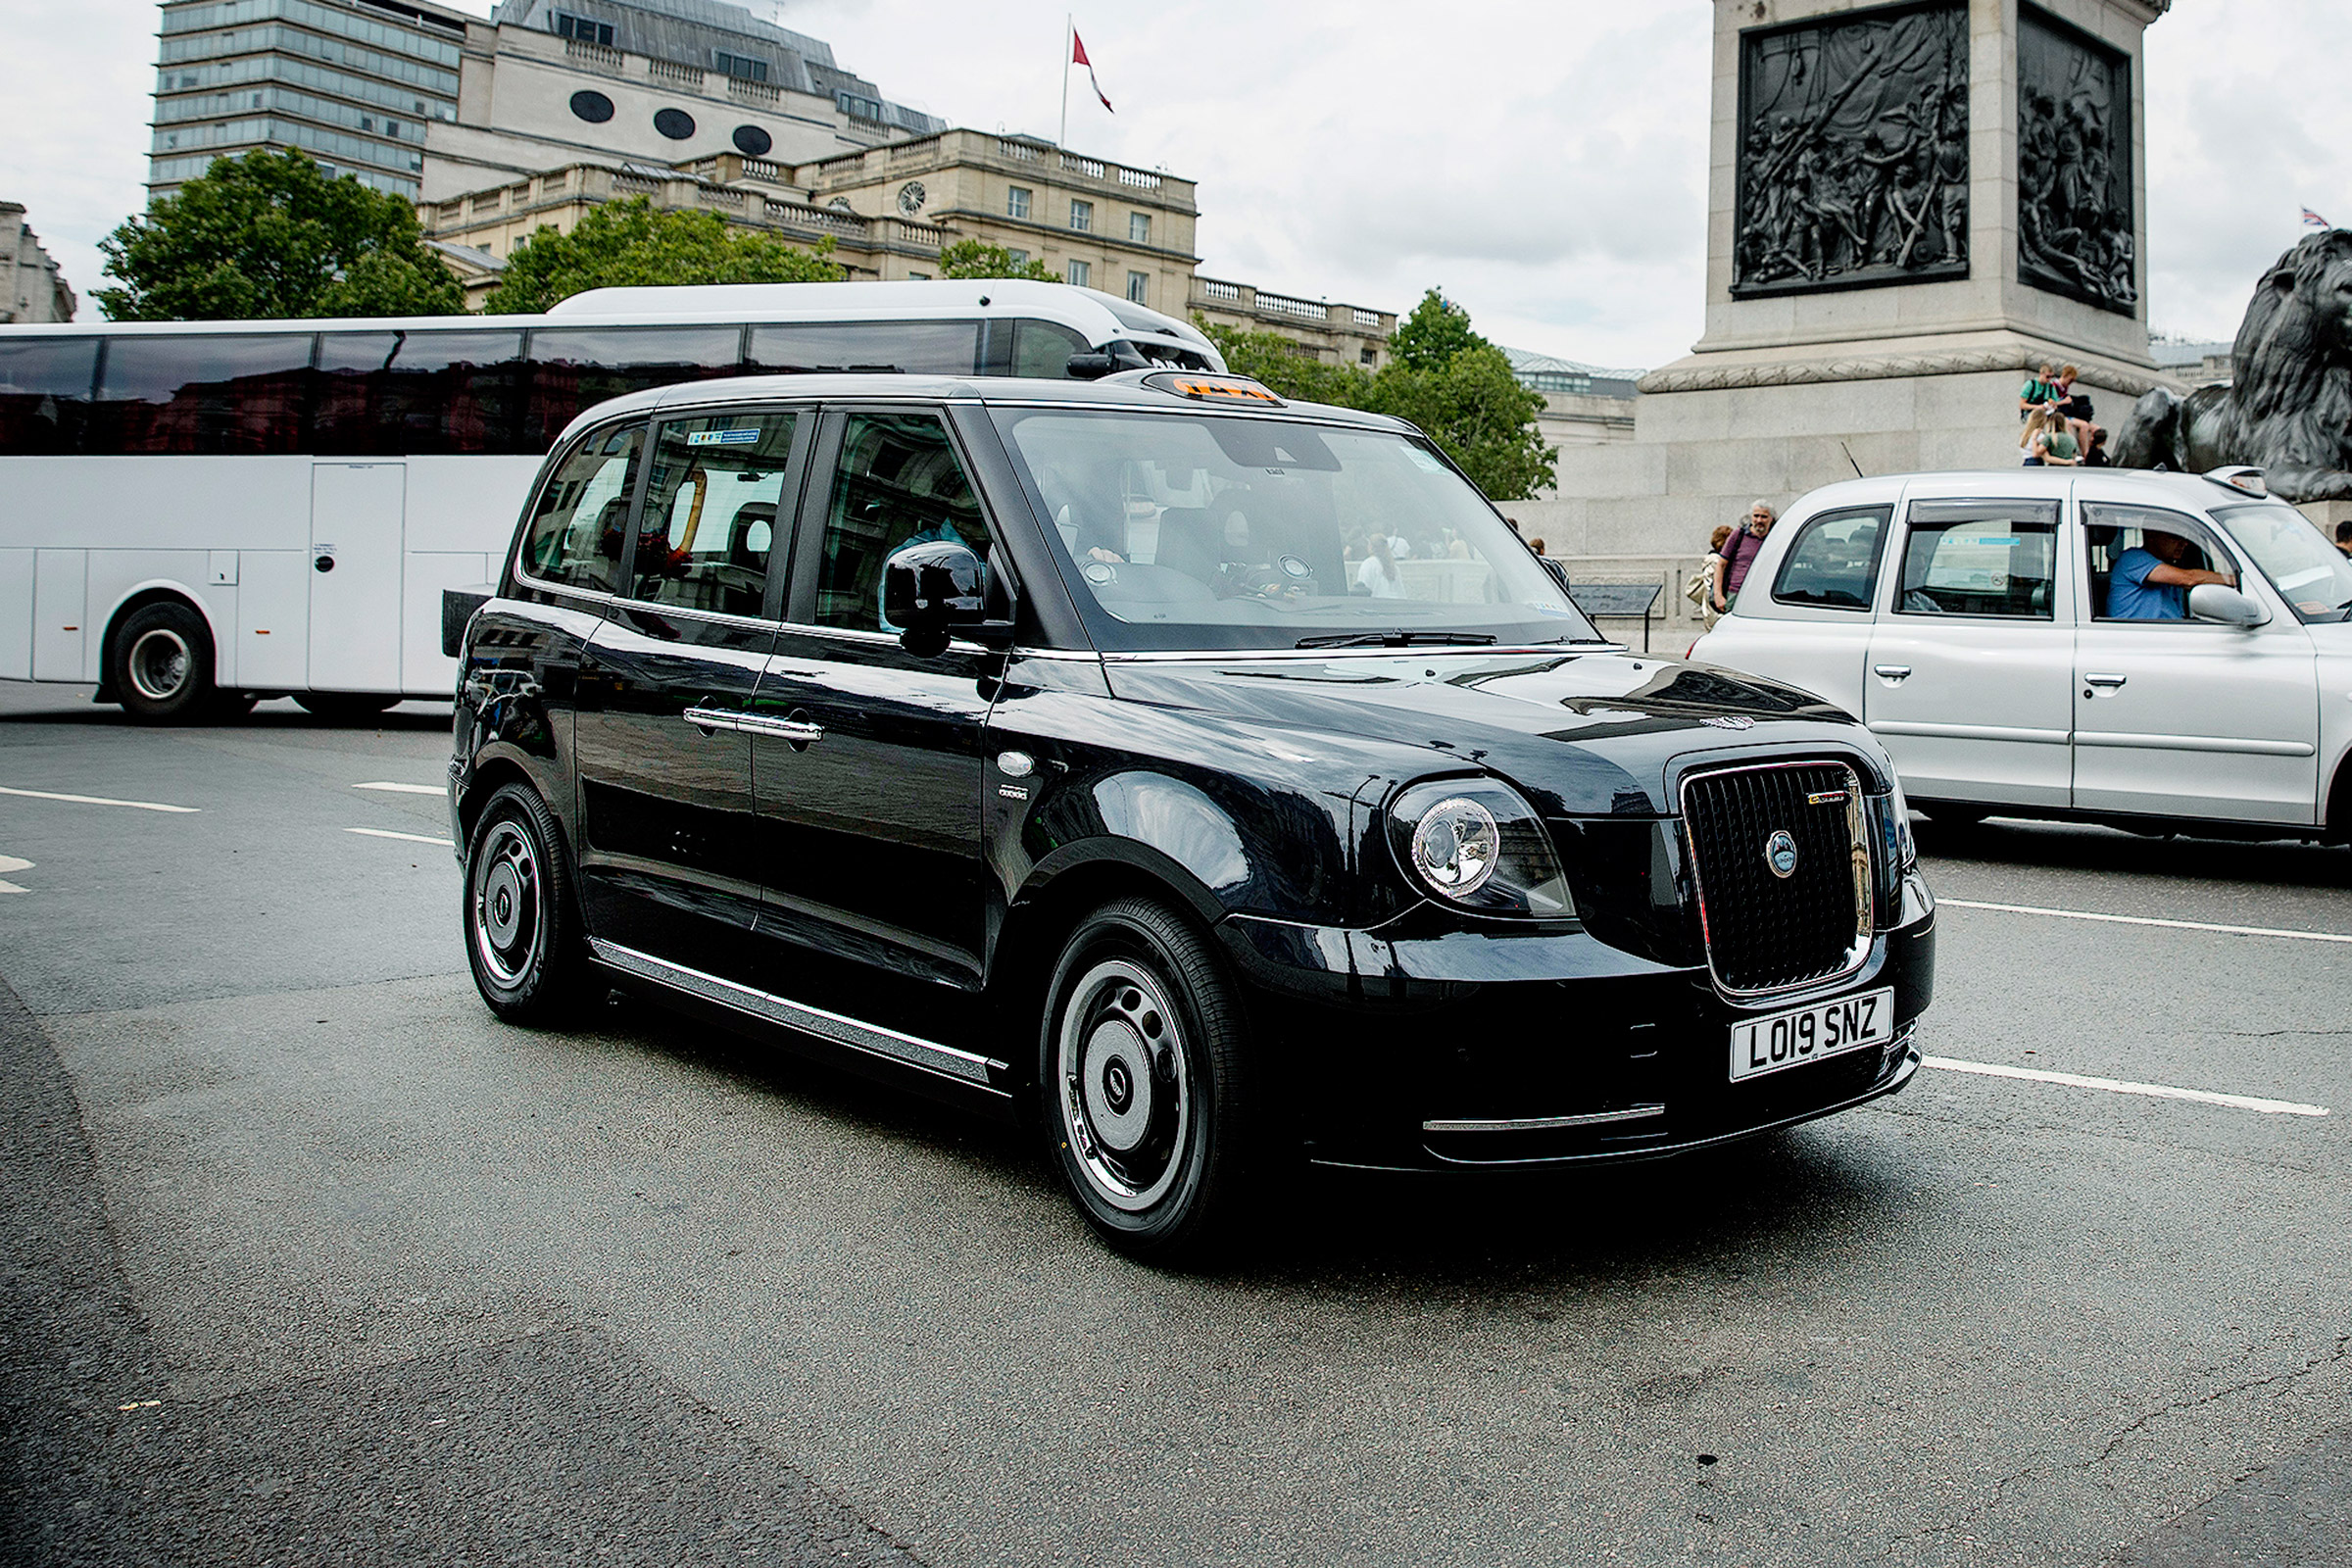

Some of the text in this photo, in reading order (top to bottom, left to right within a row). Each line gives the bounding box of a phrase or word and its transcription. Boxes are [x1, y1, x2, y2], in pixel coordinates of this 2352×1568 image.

[1180, 379, 1271, 399] TAXI
[1749, 996, 1878, 1069] LO19 SNZ
